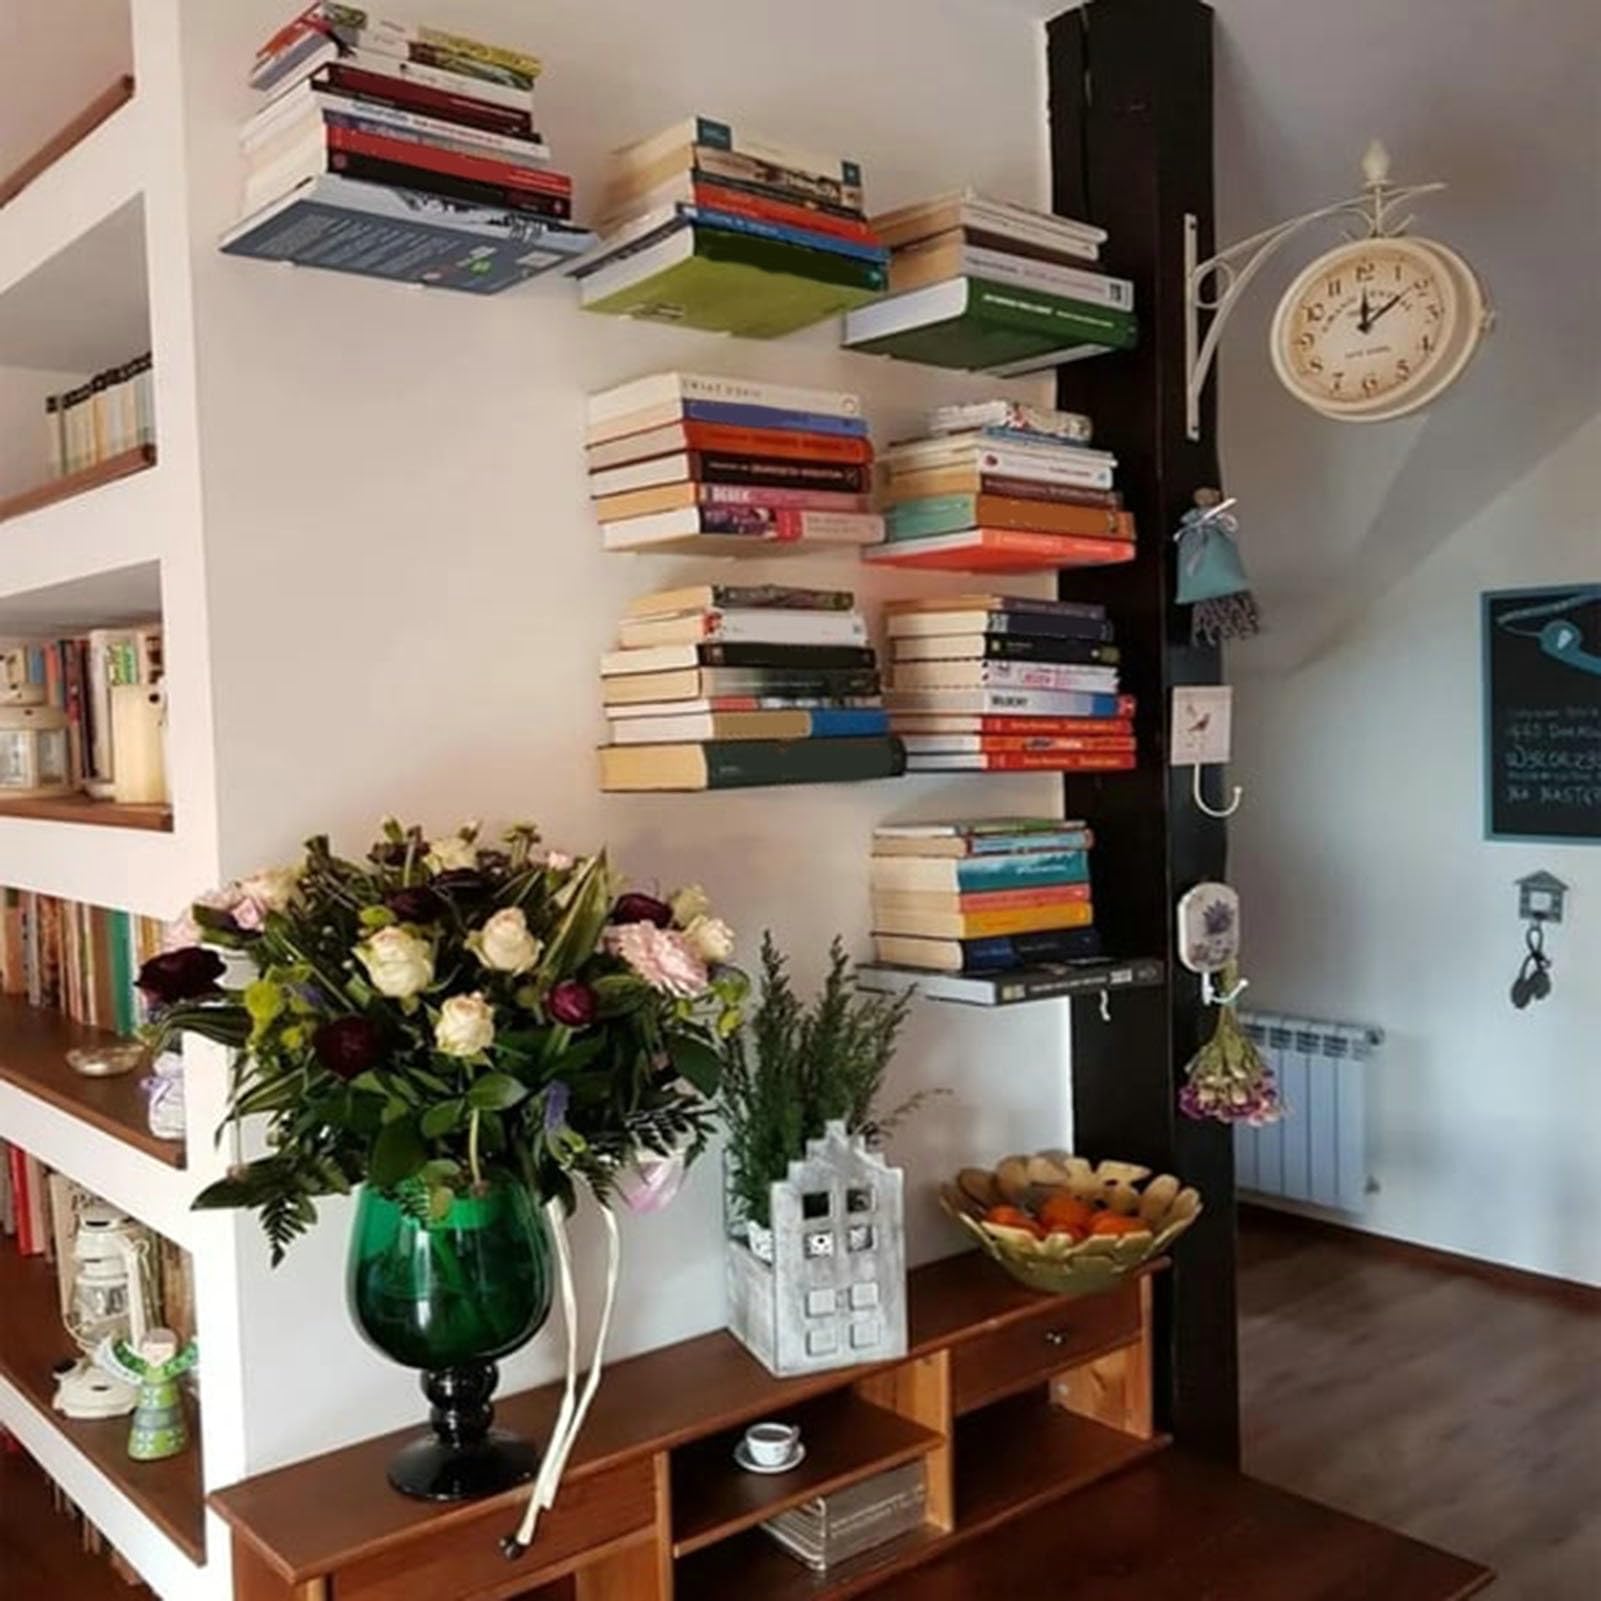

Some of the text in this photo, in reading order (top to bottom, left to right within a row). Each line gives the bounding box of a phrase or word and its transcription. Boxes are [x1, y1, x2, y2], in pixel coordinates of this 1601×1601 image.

[1356, 263, 1375, 282] 12
[1394, 265, 1402, 281] 1
[1328, 279, 1341, 297] 11
[1412, 279, 1429, 297] 2
[1302, 302, 1325, 323] 10
[1299, 333, 1315, 351] 9
[1397, 358, 1410, 382] 5
[1332, 372, 1345, 392] 7
[1361, 371, 1378, 397] 6
